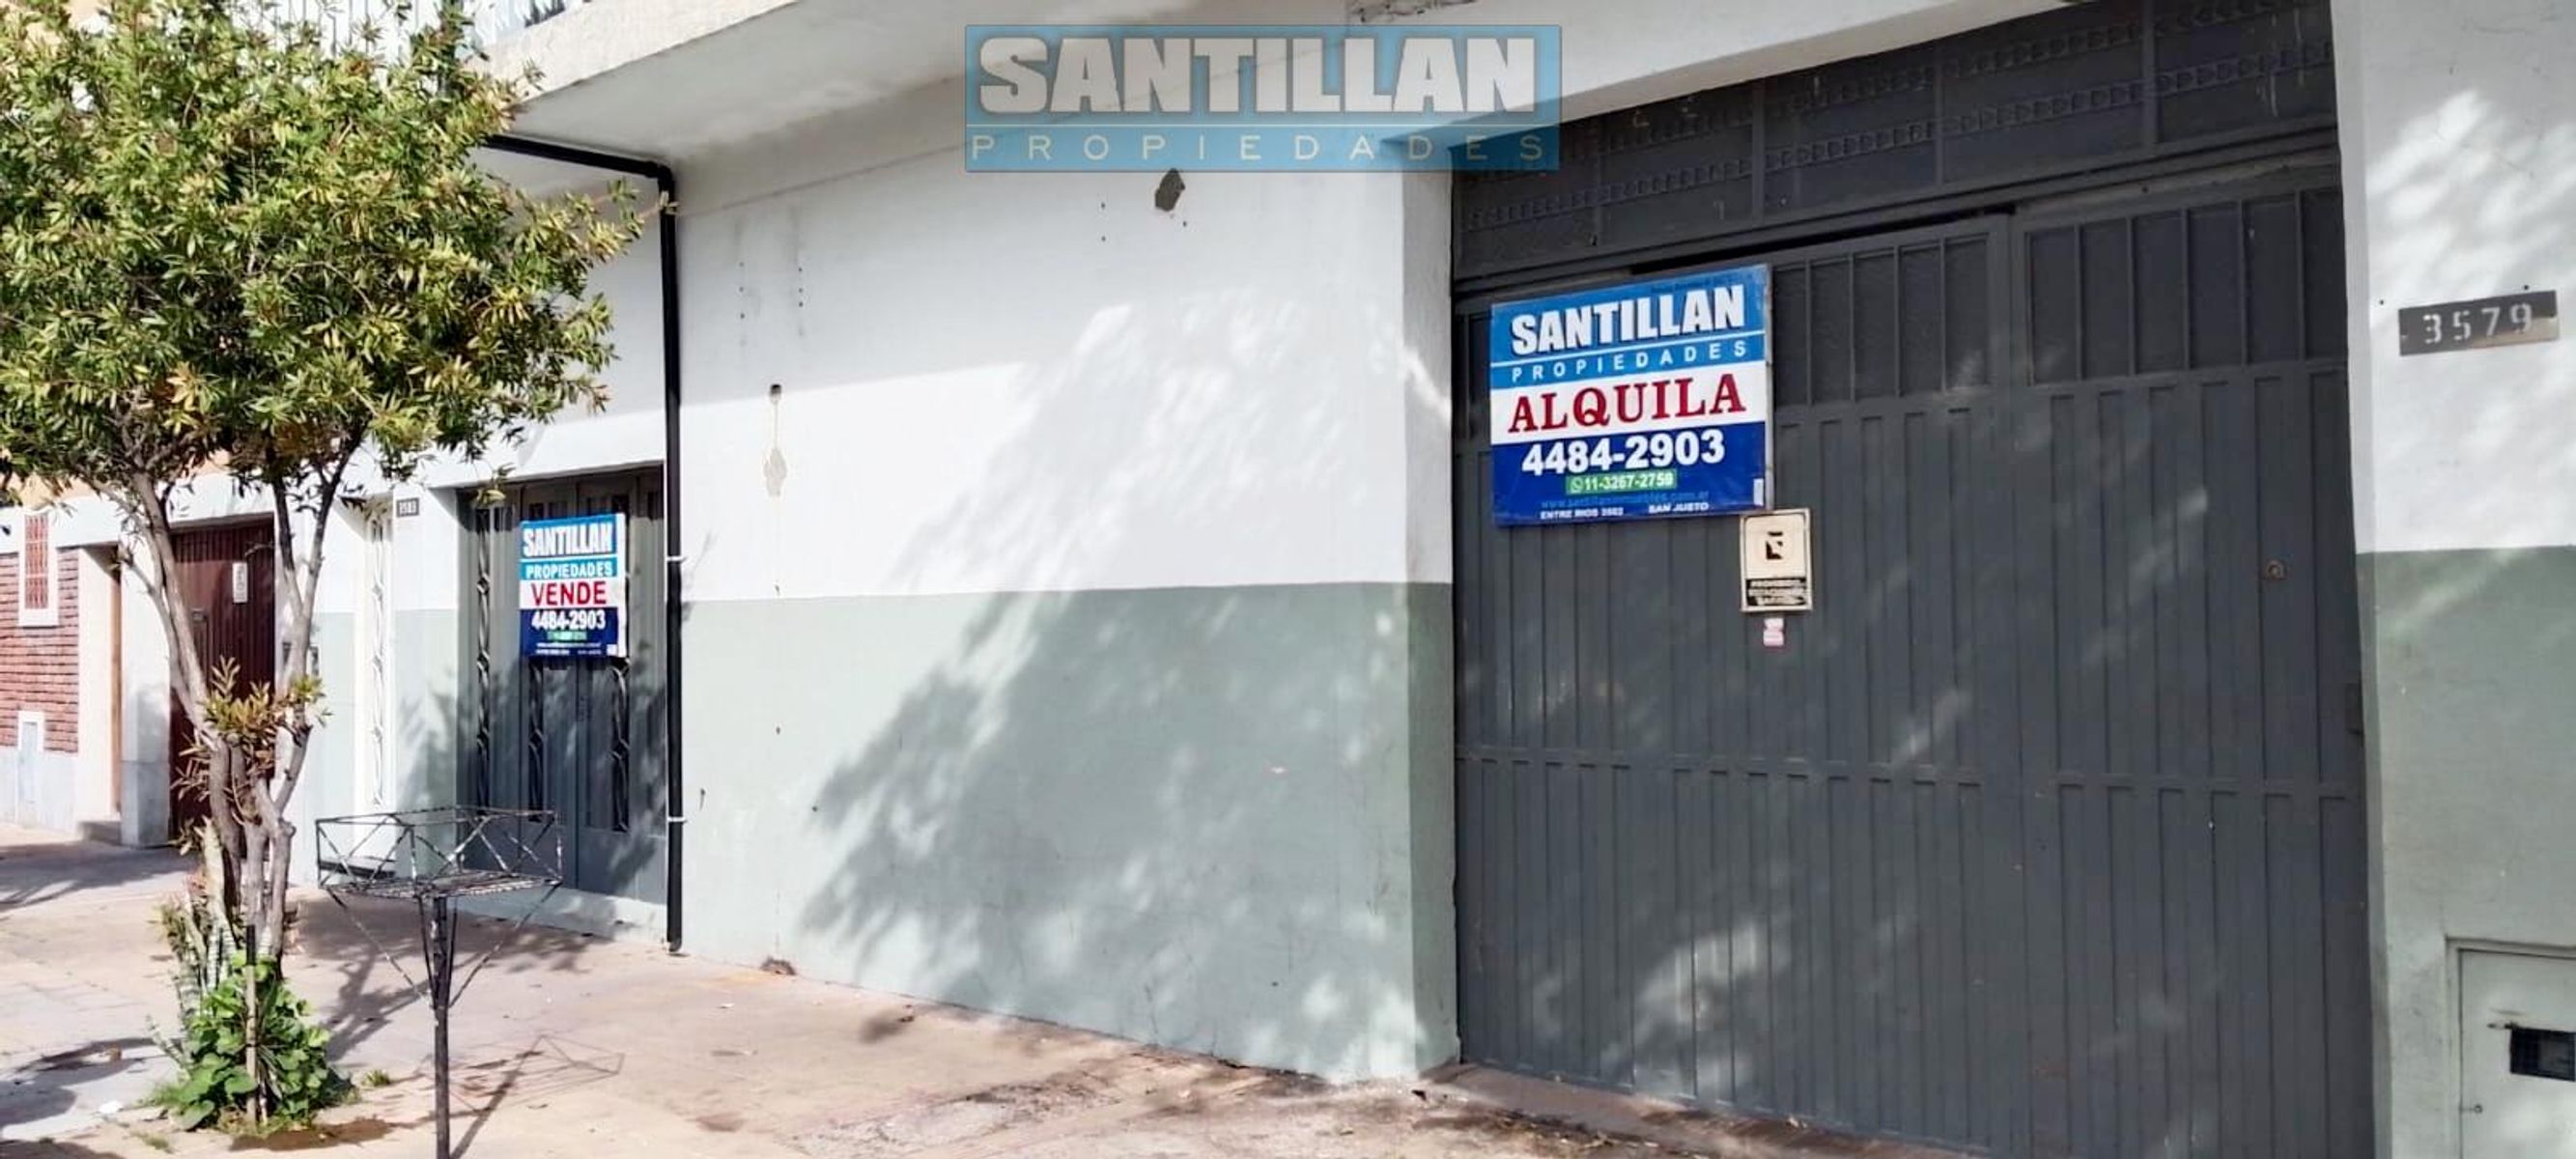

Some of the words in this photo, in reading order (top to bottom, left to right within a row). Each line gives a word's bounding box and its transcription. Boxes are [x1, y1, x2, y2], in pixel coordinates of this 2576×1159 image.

[1512, 284, 1744, 355] SANTILLAN
[2422, 302, 2533, 344] 3579
[1513, 340, 1746, 382] PROPIEDADES
[1508, 373, 1746, 433] ALQUILA
[1522, 429, 1725, 476] 4484-2903
[1541, 510, 1572, 520] ENTRE
[1648, 502, 1672, 514] SAN
[523, 522, 613, 556] SANTILLAN
[525, 561, 613, 580] PROPIEDADES
[531, 580, 607, 607] VENDE
[531, 609, 606, 630] 4484-2903
